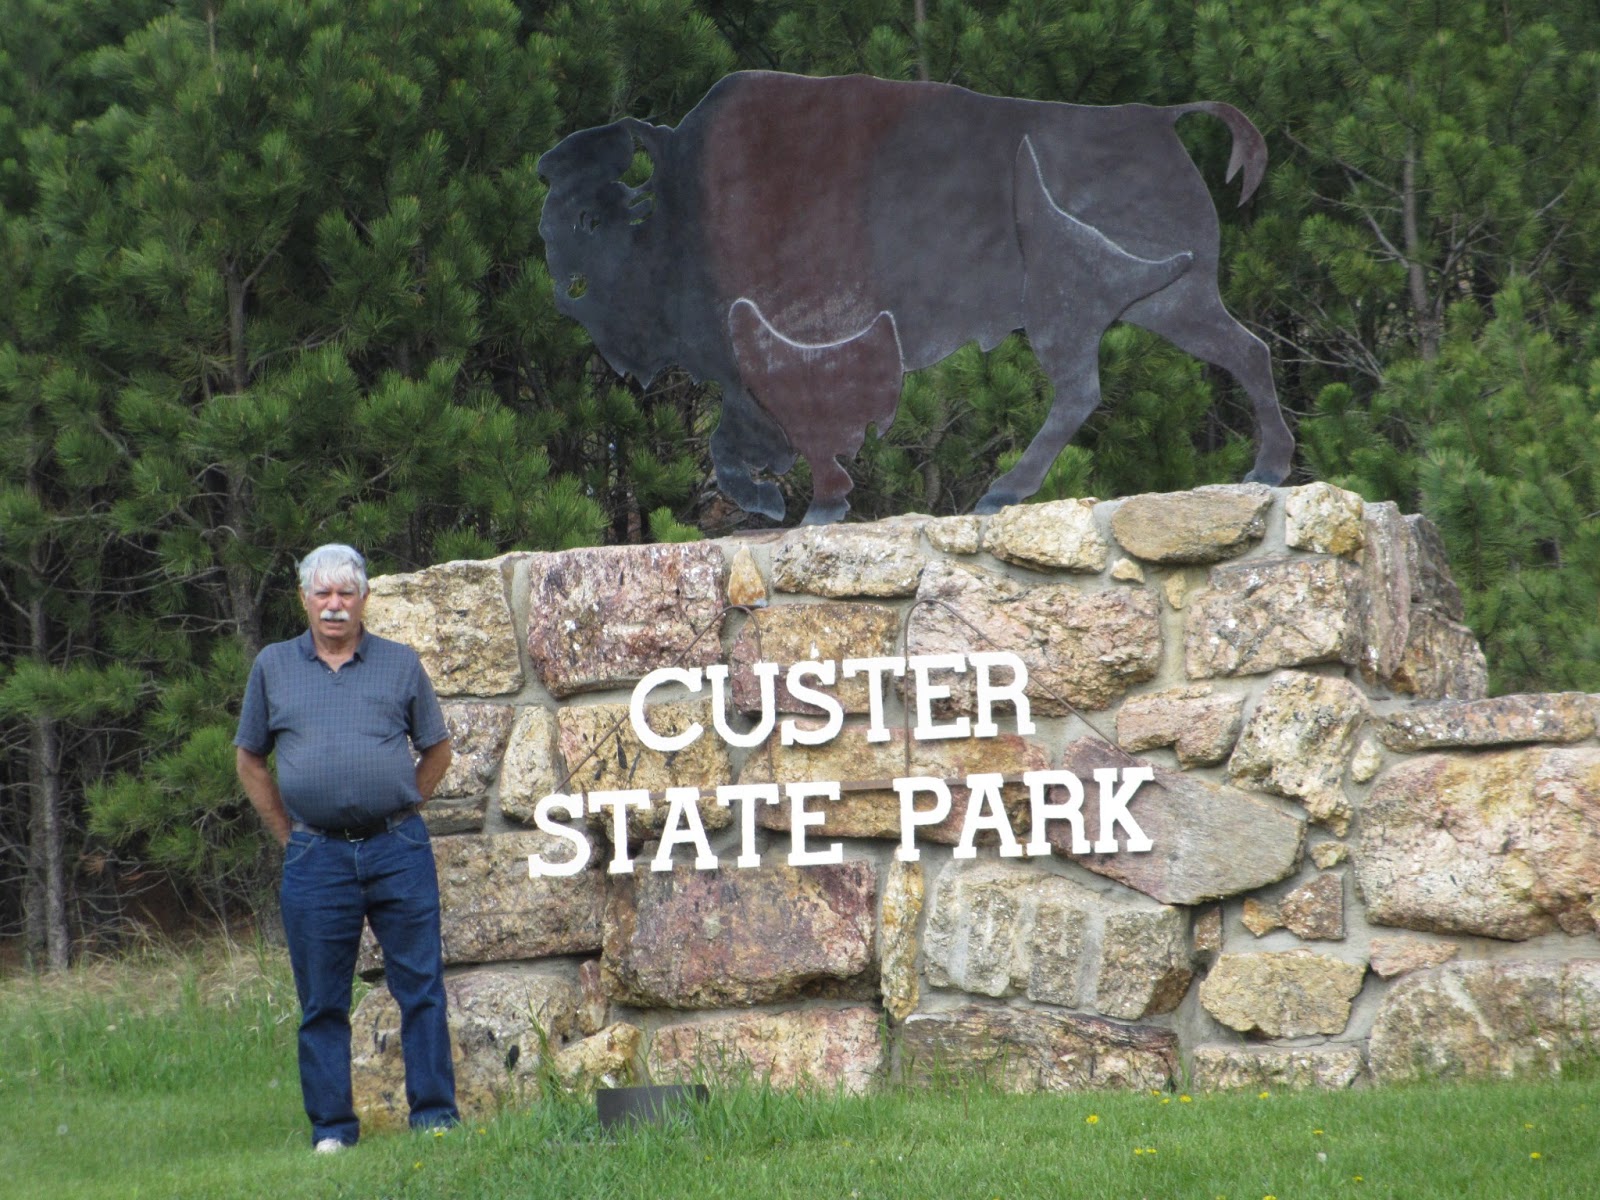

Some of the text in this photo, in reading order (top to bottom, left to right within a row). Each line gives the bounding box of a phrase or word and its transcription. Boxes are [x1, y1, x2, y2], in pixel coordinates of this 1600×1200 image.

[629, 650, 1036, 752] CUSTER
[528, 766, 1155, 878] STATE PARK
